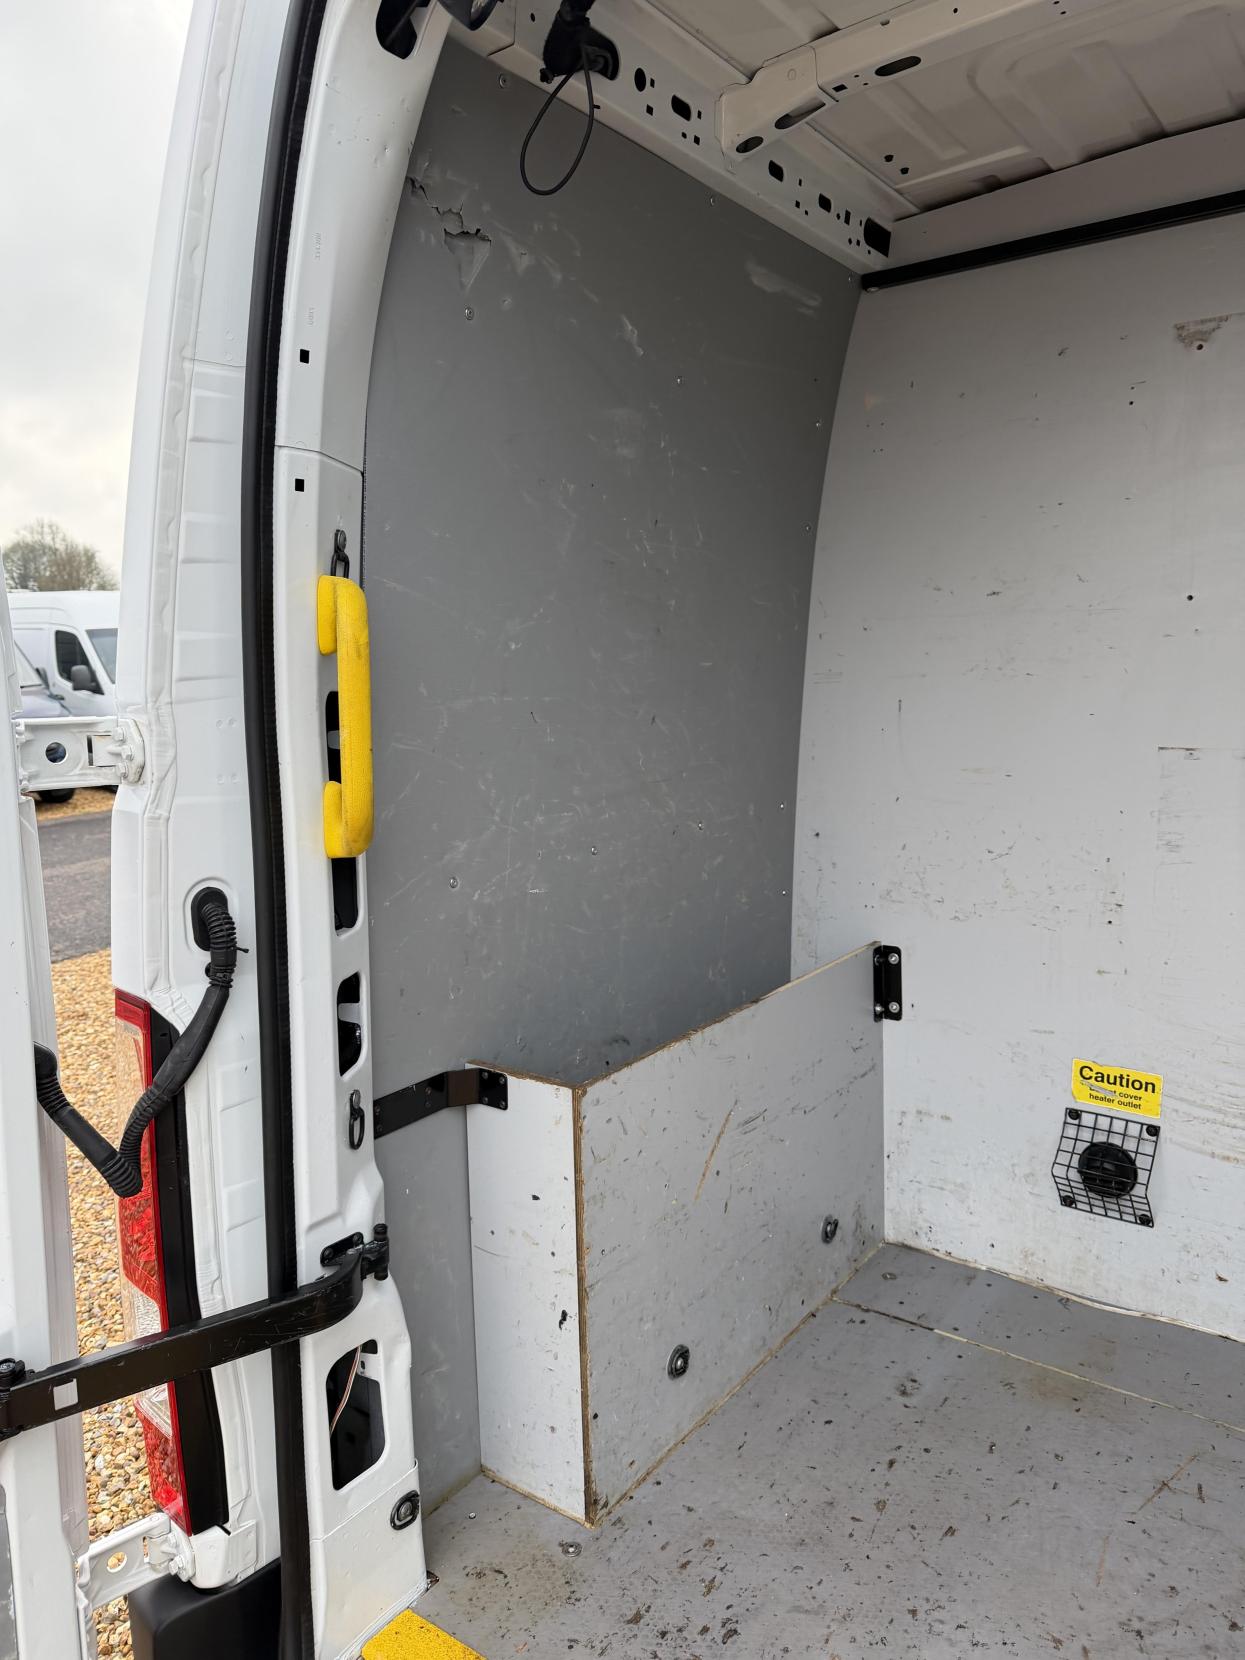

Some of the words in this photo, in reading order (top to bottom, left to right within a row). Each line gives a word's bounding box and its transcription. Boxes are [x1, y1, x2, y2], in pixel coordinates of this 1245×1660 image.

[1079, 1065, 1156, 1094] Caution
[1089, 1093, 1115, 1104] heater
[1117, 1100, 1142, 1109] outlet
[1118, 1091, 1142, 1101] cover
